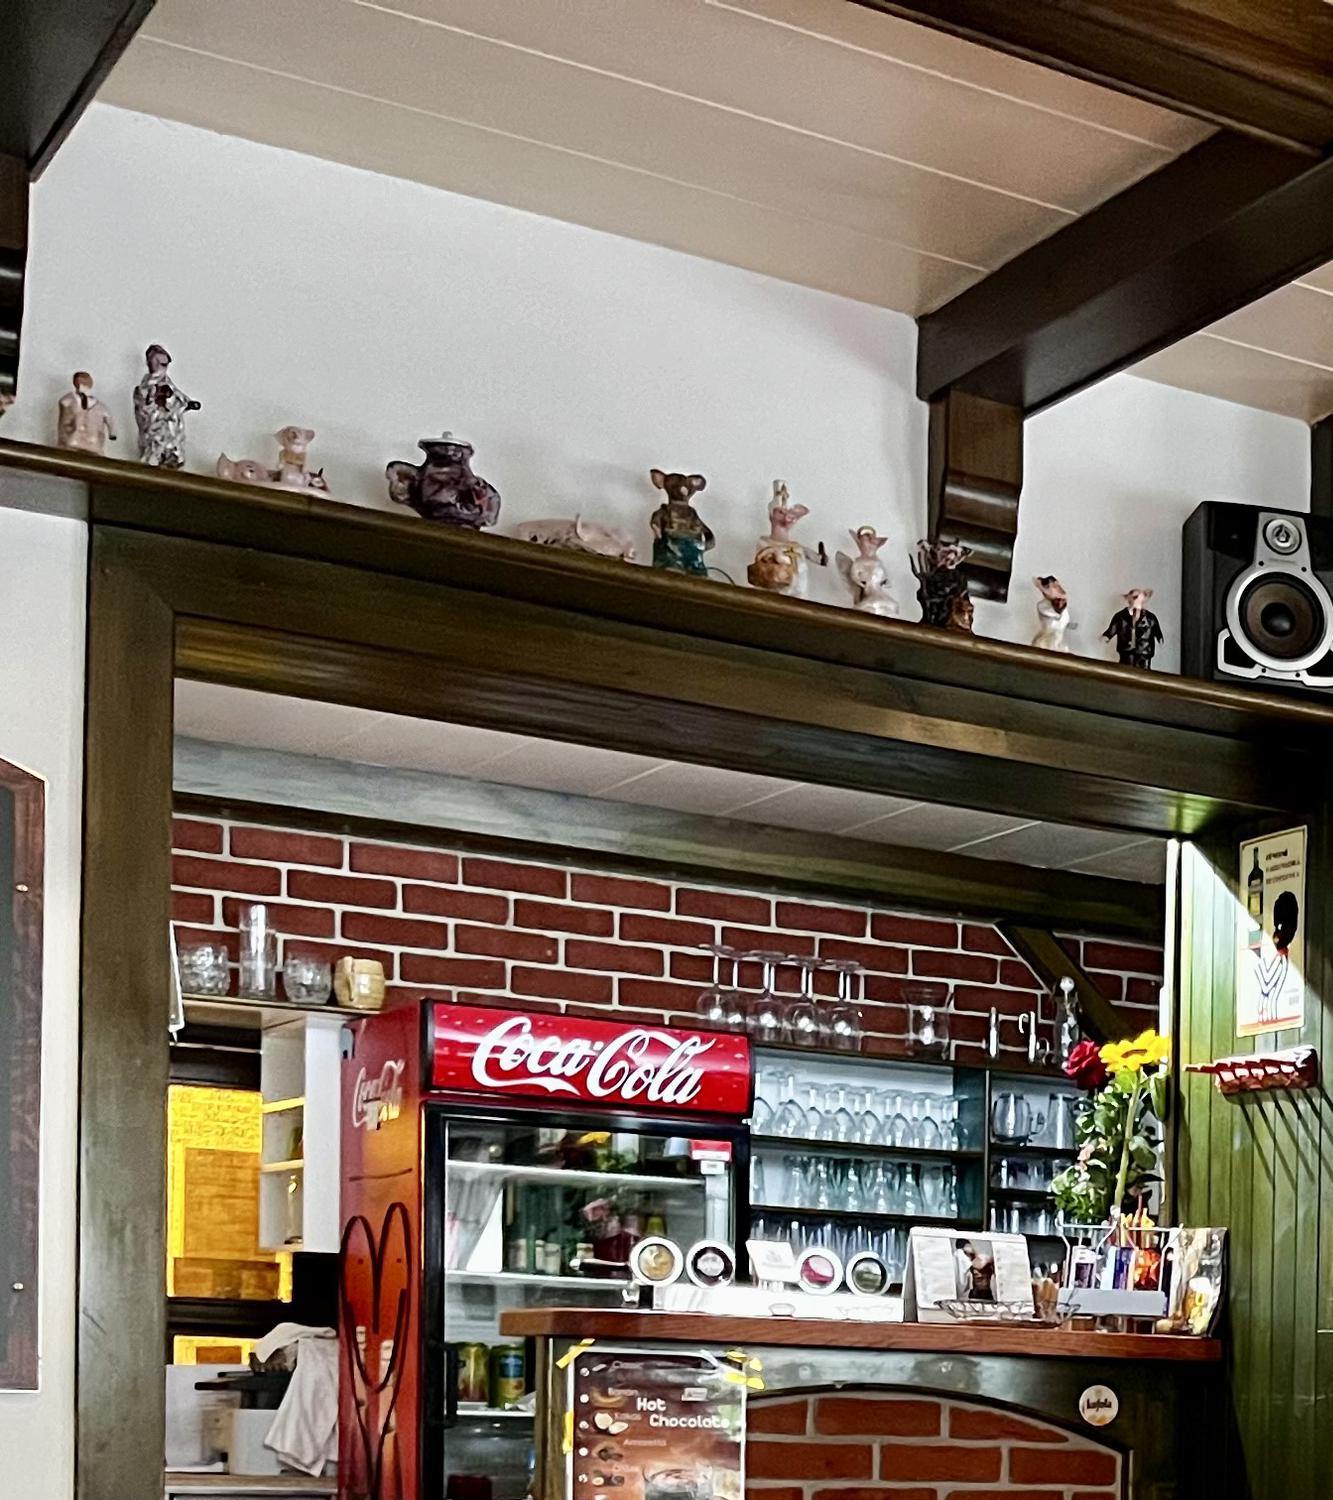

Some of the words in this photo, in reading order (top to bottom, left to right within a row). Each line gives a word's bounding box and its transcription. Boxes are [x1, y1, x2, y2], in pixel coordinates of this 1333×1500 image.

[471, 1016, 718, 1105] Coca-Cola
[636, 1397, 667, 1412] Hot
[649, 1413, 730, 1429] Chocolate
